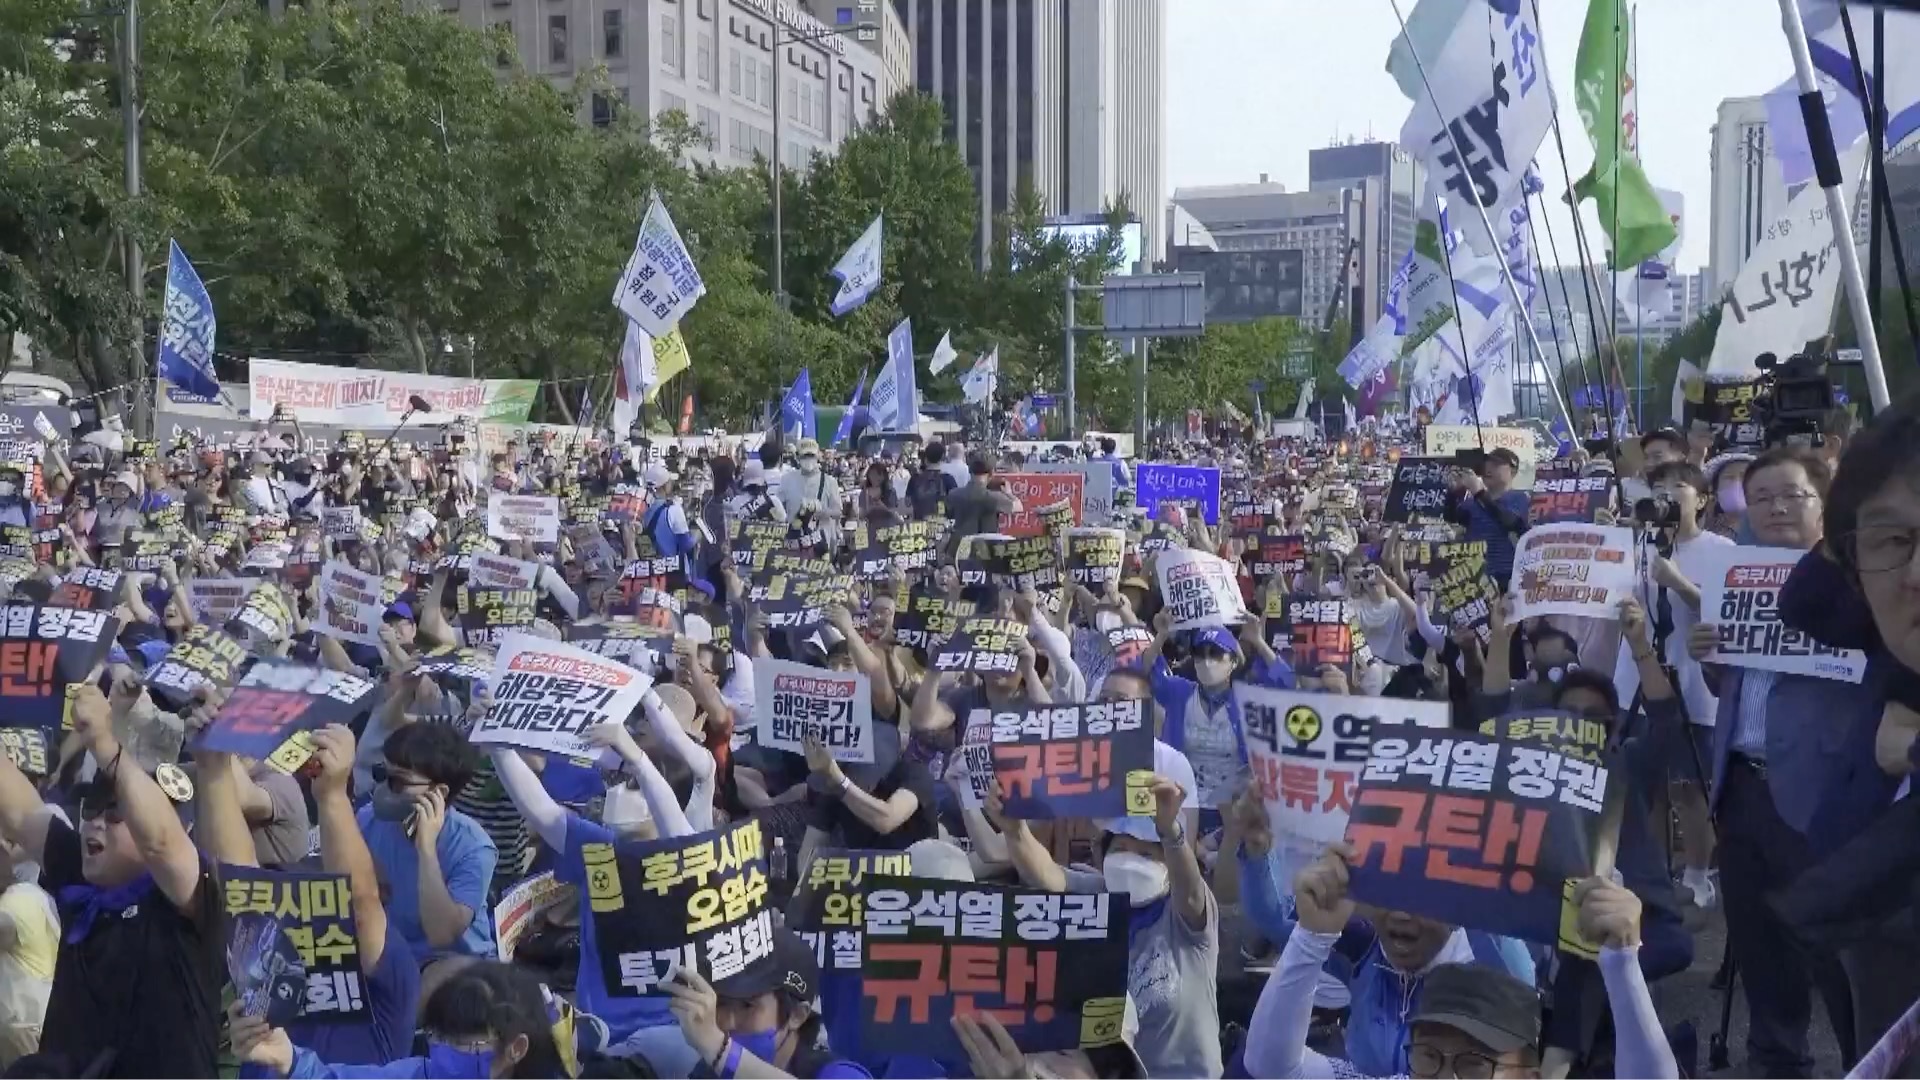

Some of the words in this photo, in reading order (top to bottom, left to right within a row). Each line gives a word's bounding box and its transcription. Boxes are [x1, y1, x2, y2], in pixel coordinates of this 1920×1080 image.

[37, 604, 107, 643] 정권
[924, 613, 959, 635] 오염
[935, 651, 973, 672] 투기
[974, 651, 1020, 672] 철회!
[493, 672, 618, 711] 해양투기
[772, 693, 854, 724] 해양투기
[772, 717, 861, 749] 반대한다!
[991, 706, 1079, 743] 윤석열
[1085, 697, 1143, 735] 정권
[1507, 716, 1608, 751] 후쿠시마
[993, 738, 1112, 800] 규탄!
[1362, 737, 1501, 792] 윤석열
[1506, 746, 1610, 816] 정권
[641, 818, 765, 897] 후쿠시마
[1344, 788, 1550, 896] 규탄!
[224, 878, 352, 923] 후쿠시마
[685, 866, 769, 935] 오염수
[863, 888, 1004, 939] 윤석열
[1012, 892, 1110, 941] 정권
[618, 940, 698, 995] 투기
[705, 908, 775, 983] 철회!
[862, 942, 1058, 1026] 규탄!
